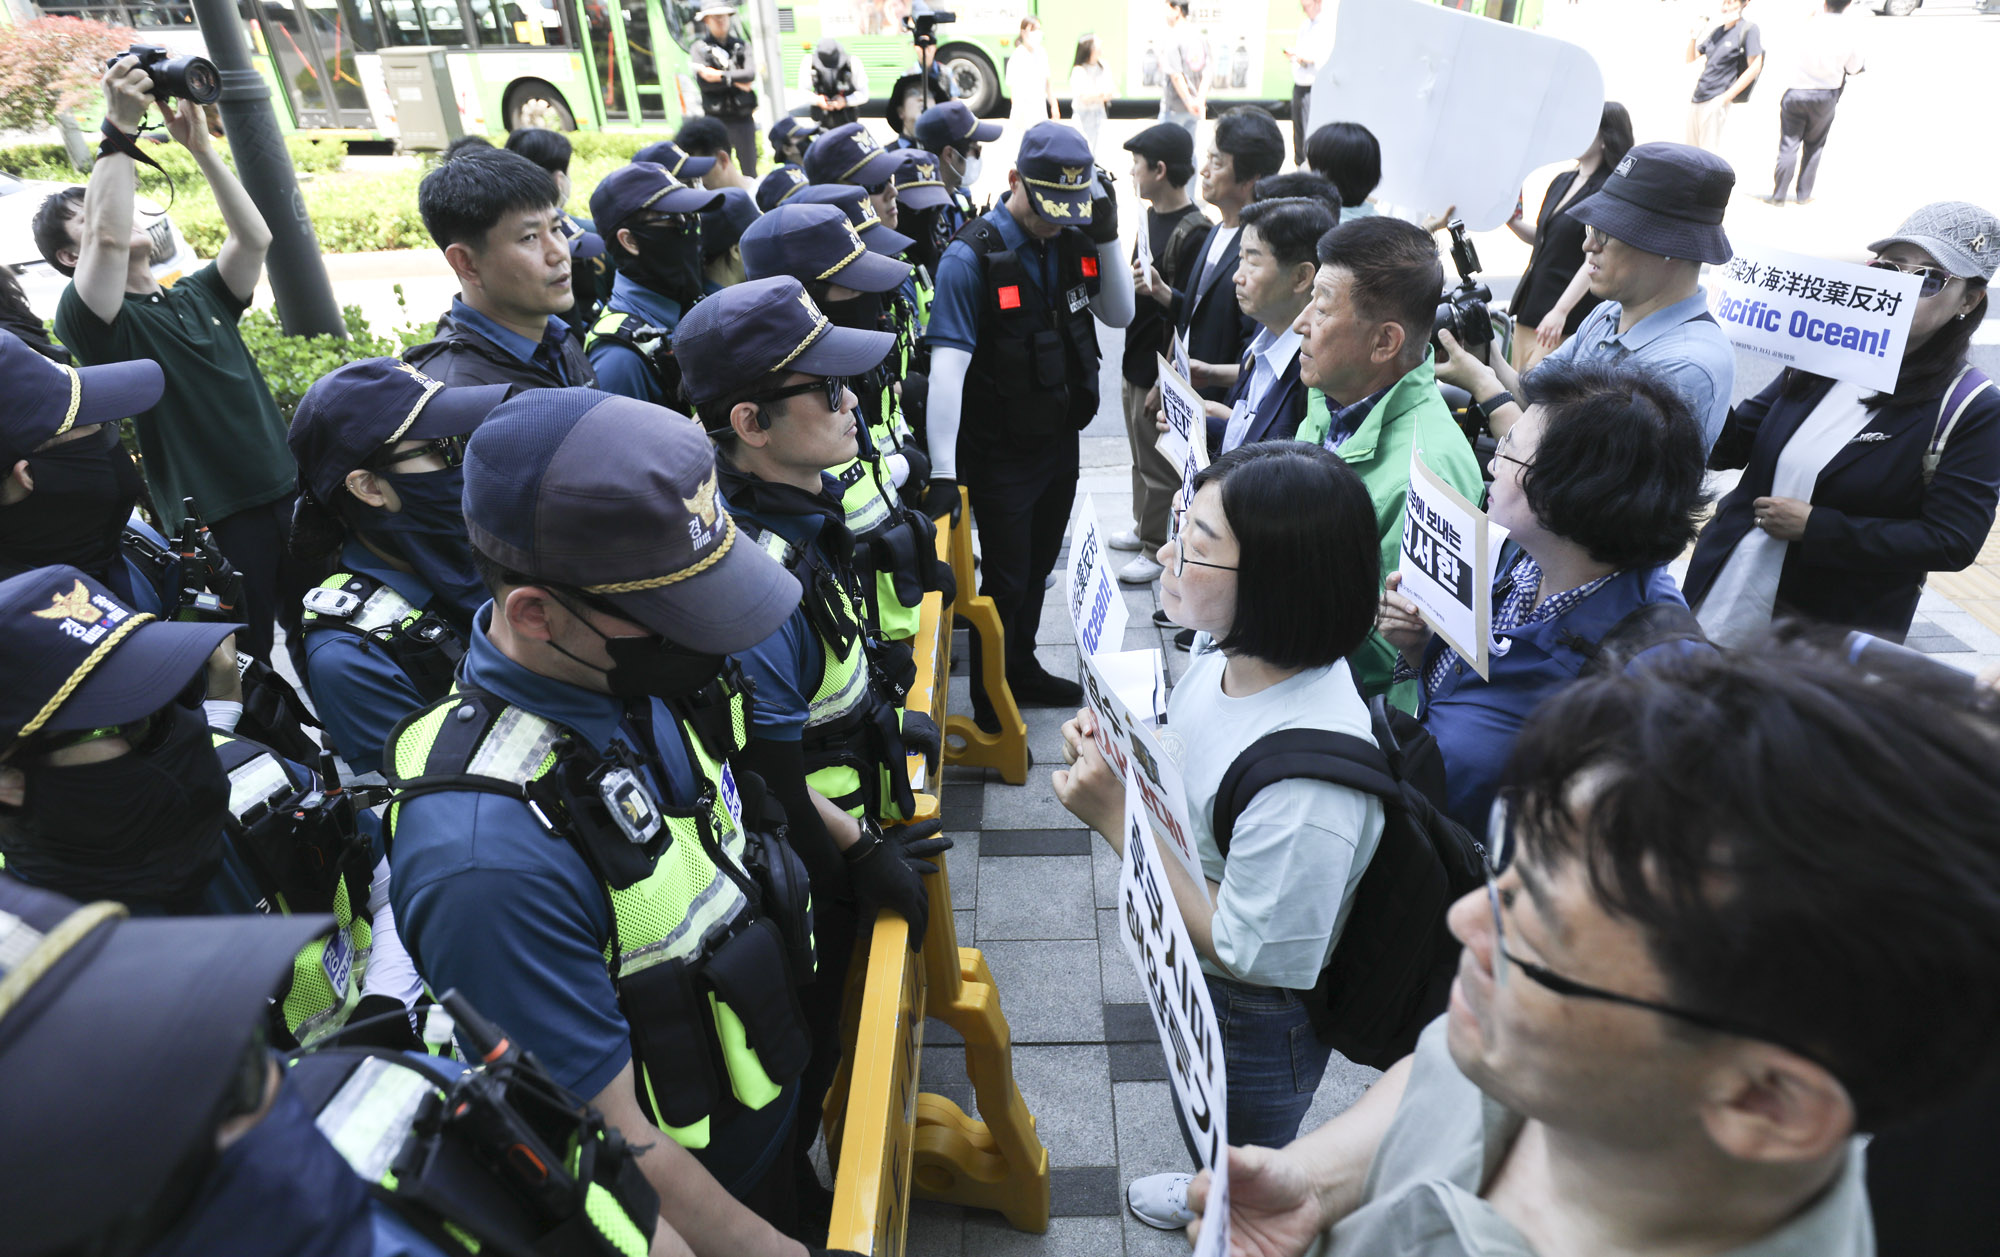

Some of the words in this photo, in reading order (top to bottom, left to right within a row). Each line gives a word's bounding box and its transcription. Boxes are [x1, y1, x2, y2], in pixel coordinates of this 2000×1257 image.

[1718, 291, 1782, 332] Pacific
[1788, 310, 1891, 358] Ocean!
[1759, 266, 1903, 316] 海洋投棄反対
[1426, 505, 1462, 553] 보내는
[1130, 812, 1214, 1089] 후쿠시마
[1126, 888, 1218, 1171] 해양투기
